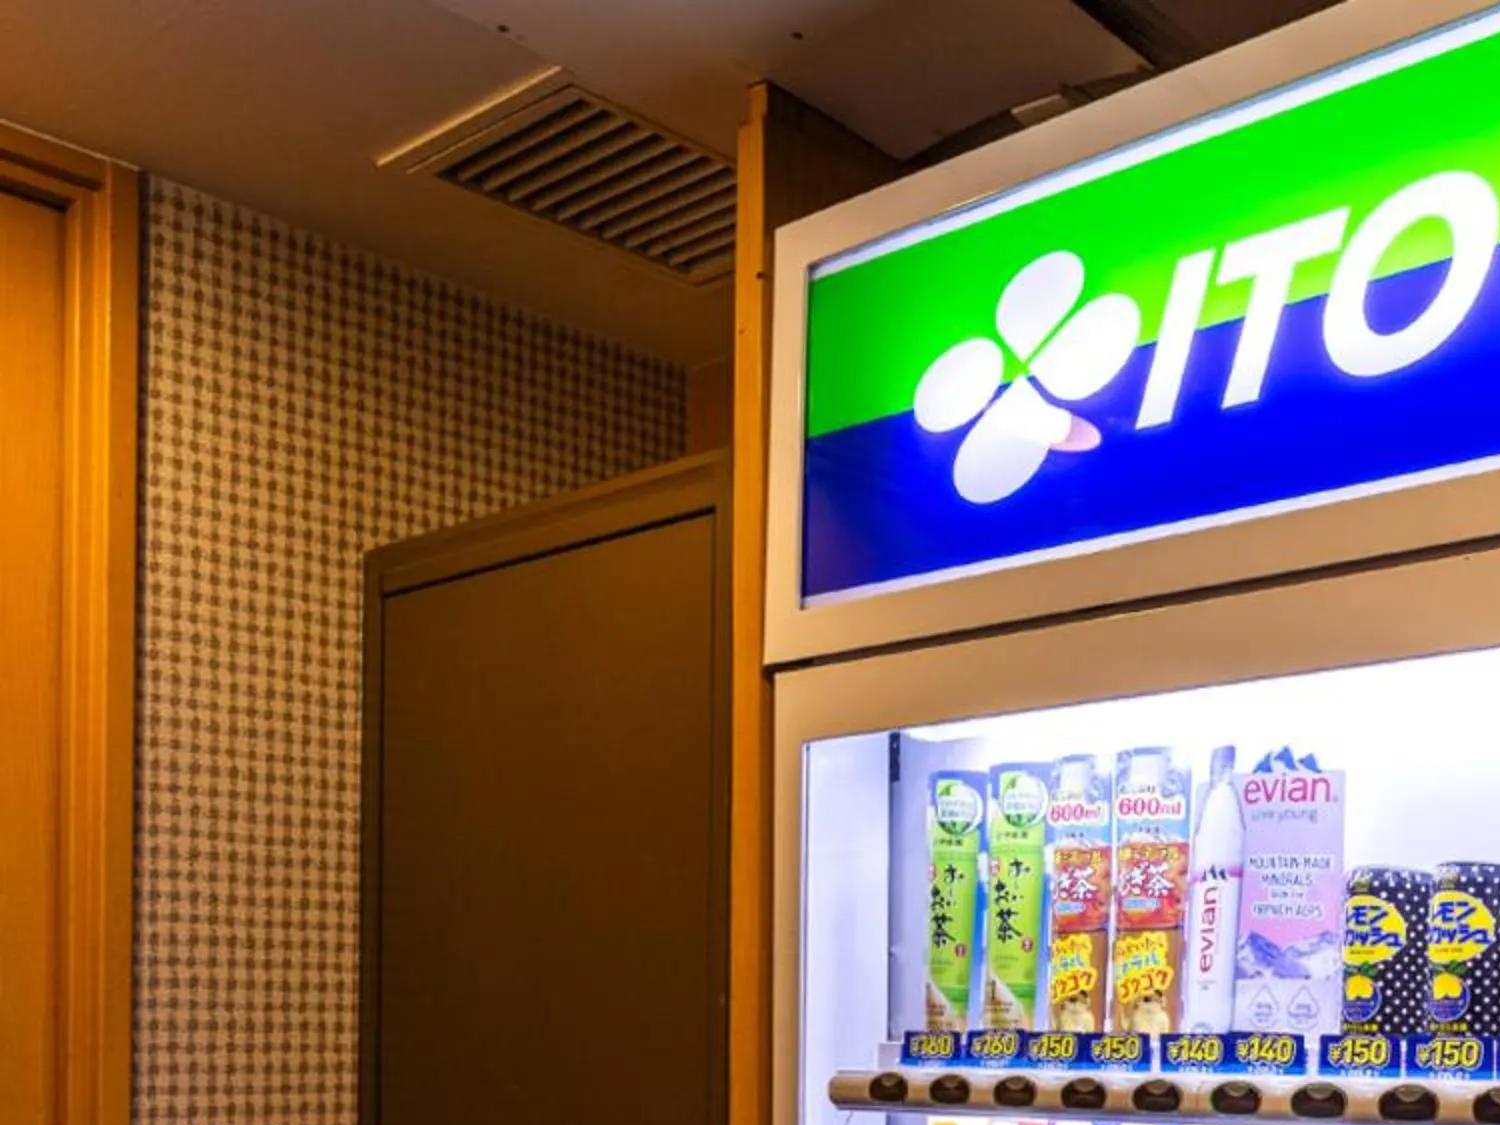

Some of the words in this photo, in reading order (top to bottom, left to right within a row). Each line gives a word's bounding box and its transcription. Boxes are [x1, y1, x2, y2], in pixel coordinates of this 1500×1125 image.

[1134, 170, 1500, 430] ITO
[1243, 772, 1331, 804] evian
[1118, 797, 1182, 816] 600ml
[1199, 885, 1218, 974] evian
[1029, 1035, 1077, 1059] ¥150
[1091, 1036, 1141, 1060] ¥150
[1168, 1036, 1222, 1063] ¥140
[1236, 1034, 1295, 1063] ¥140
[1330, 1037, 1387, 1066] ¥150
[1418, 1039, 1481, 1068] ¥150
